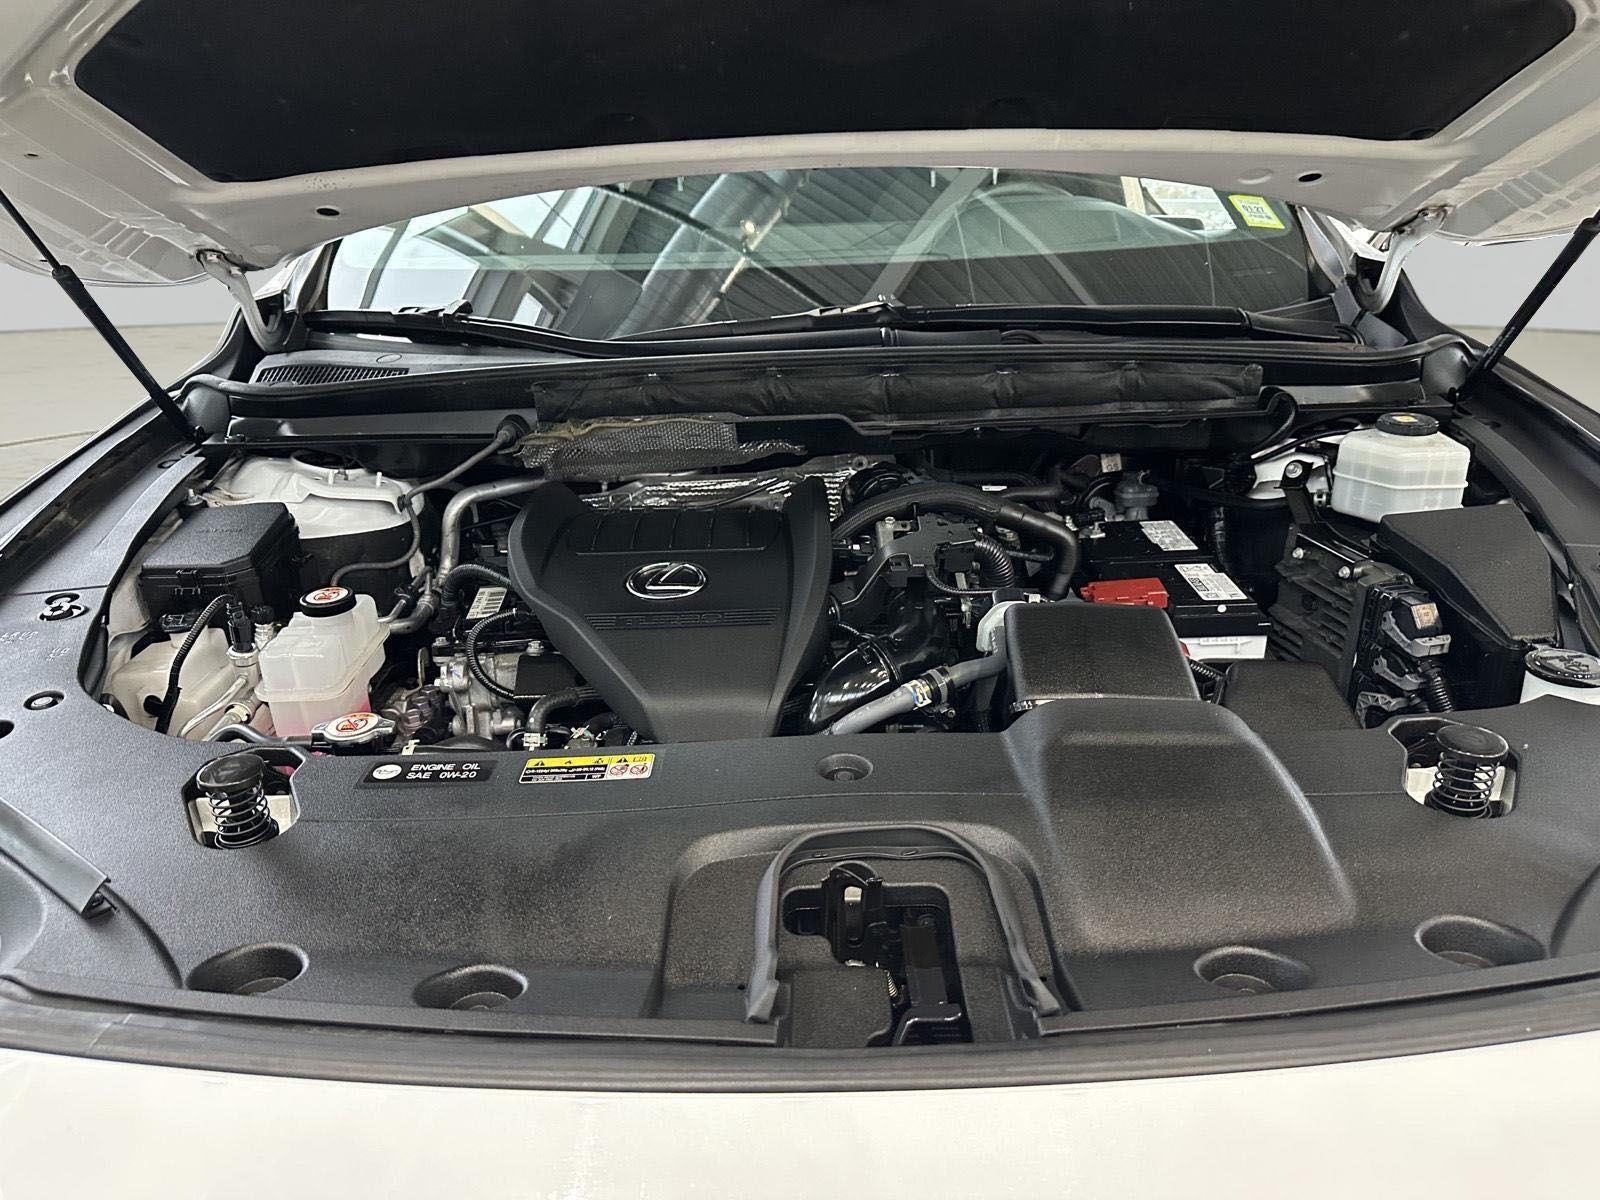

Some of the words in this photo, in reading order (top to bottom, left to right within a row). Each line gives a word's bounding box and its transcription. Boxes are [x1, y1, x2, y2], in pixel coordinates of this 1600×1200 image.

[410, 763, 456, 771] ENGINE
[406, 771, 432, 779] SAE
[439, 771, 477, 779] 0W-20
